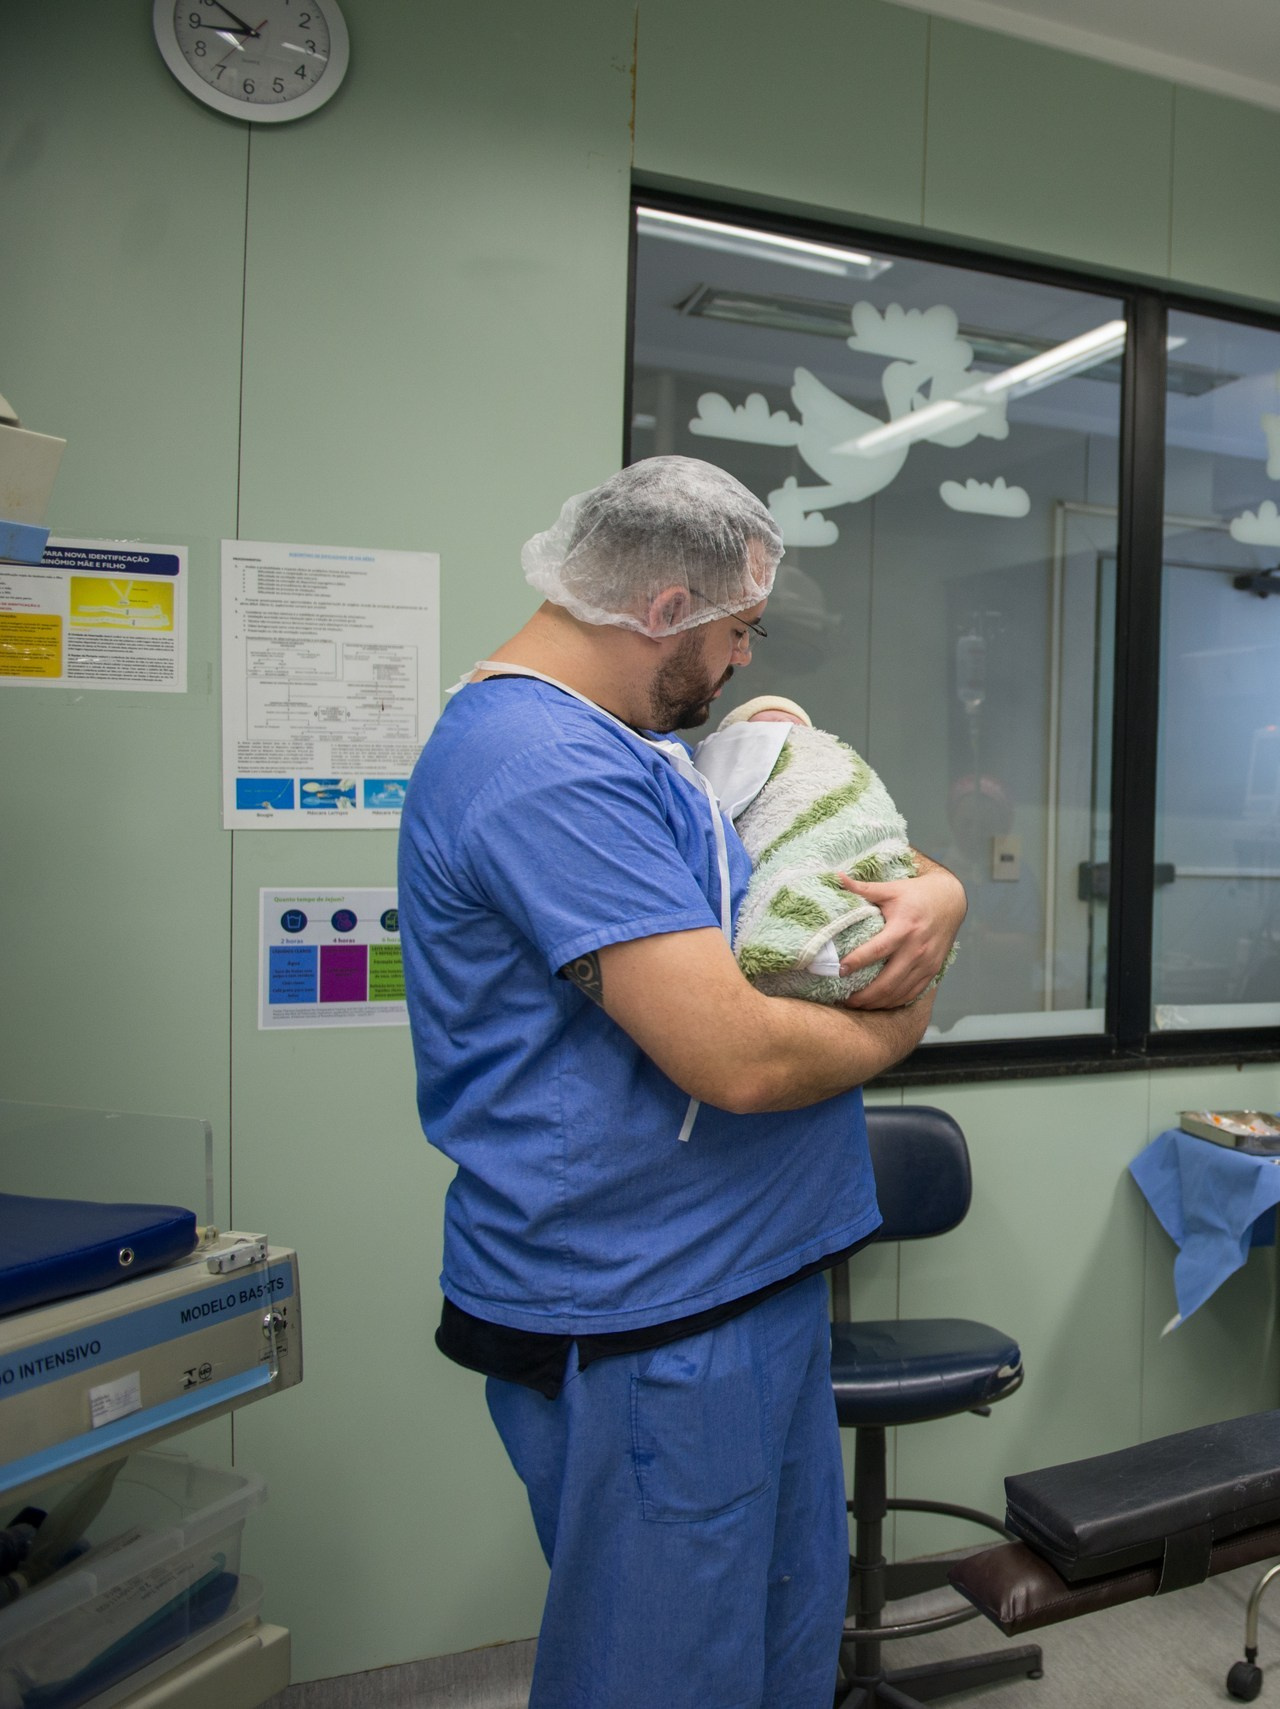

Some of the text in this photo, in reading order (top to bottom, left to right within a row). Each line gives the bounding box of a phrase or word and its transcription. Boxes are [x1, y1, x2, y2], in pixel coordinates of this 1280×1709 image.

[298, 12, 311, 29] 2
[194, 40, 206, 57] 8
[214, 63, 227, 80] 7
[294, 64, 307, 80] 4
[243, 78, 255, 95] 6
[272, 77, 285, 94] 5
[88, 553, 150, 563] IDENTIFICAÇÃO
[181, 1294, 236, 1324] MODELO
[19, 1340, 102, 1379] INTENSIVO
